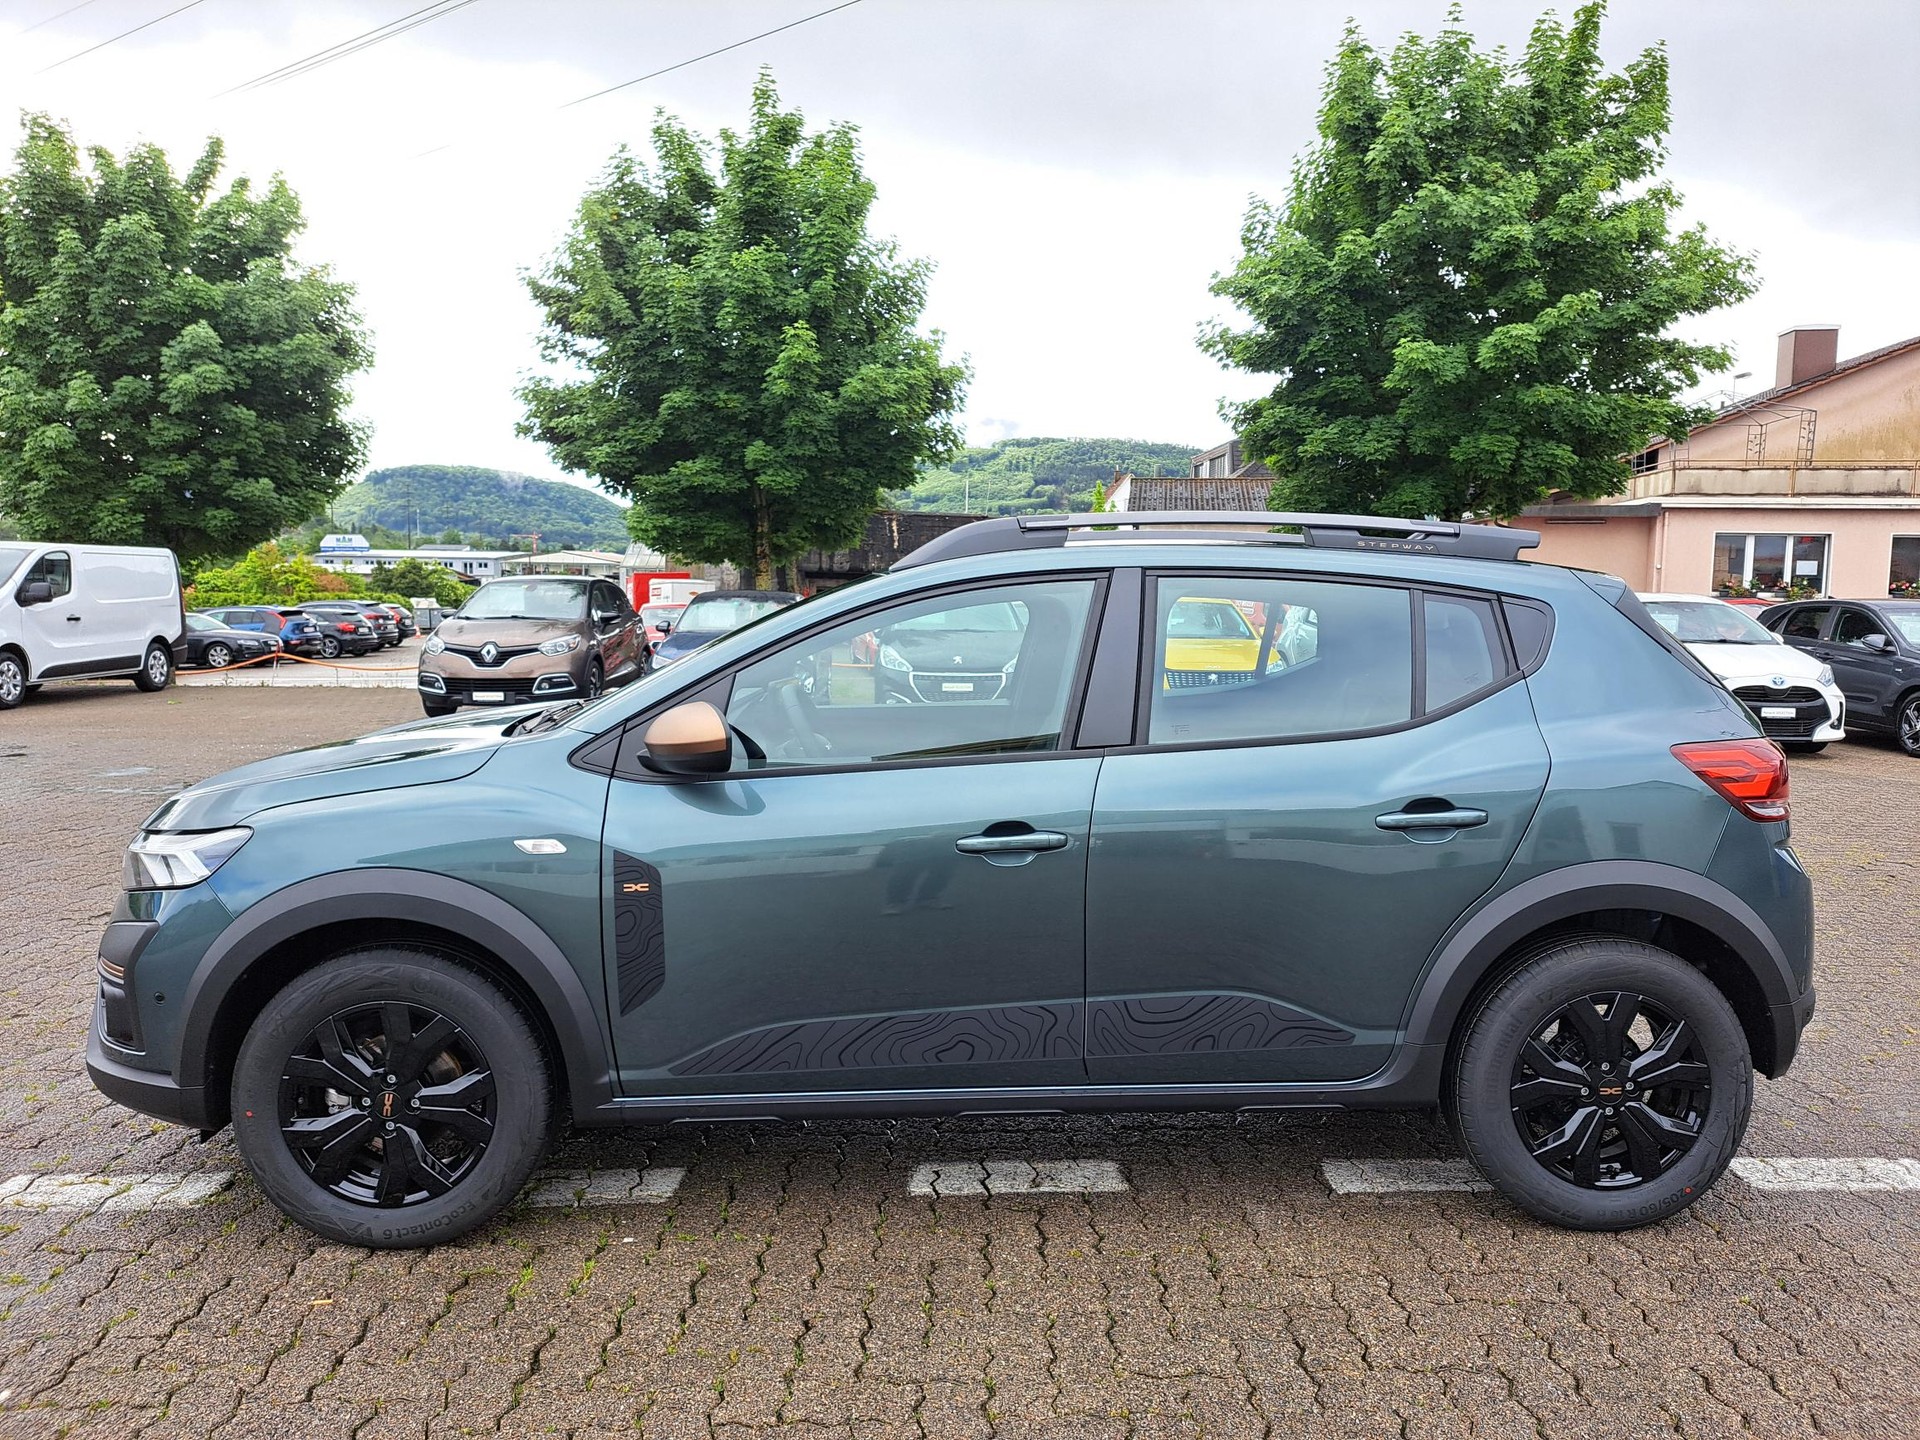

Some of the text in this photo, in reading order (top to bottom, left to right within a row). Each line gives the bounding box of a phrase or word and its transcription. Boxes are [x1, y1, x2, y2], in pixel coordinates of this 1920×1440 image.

[1357, 540, 1435, 551] STEPWAY
[382, 1199, 477, 1240] EcoContact 6
